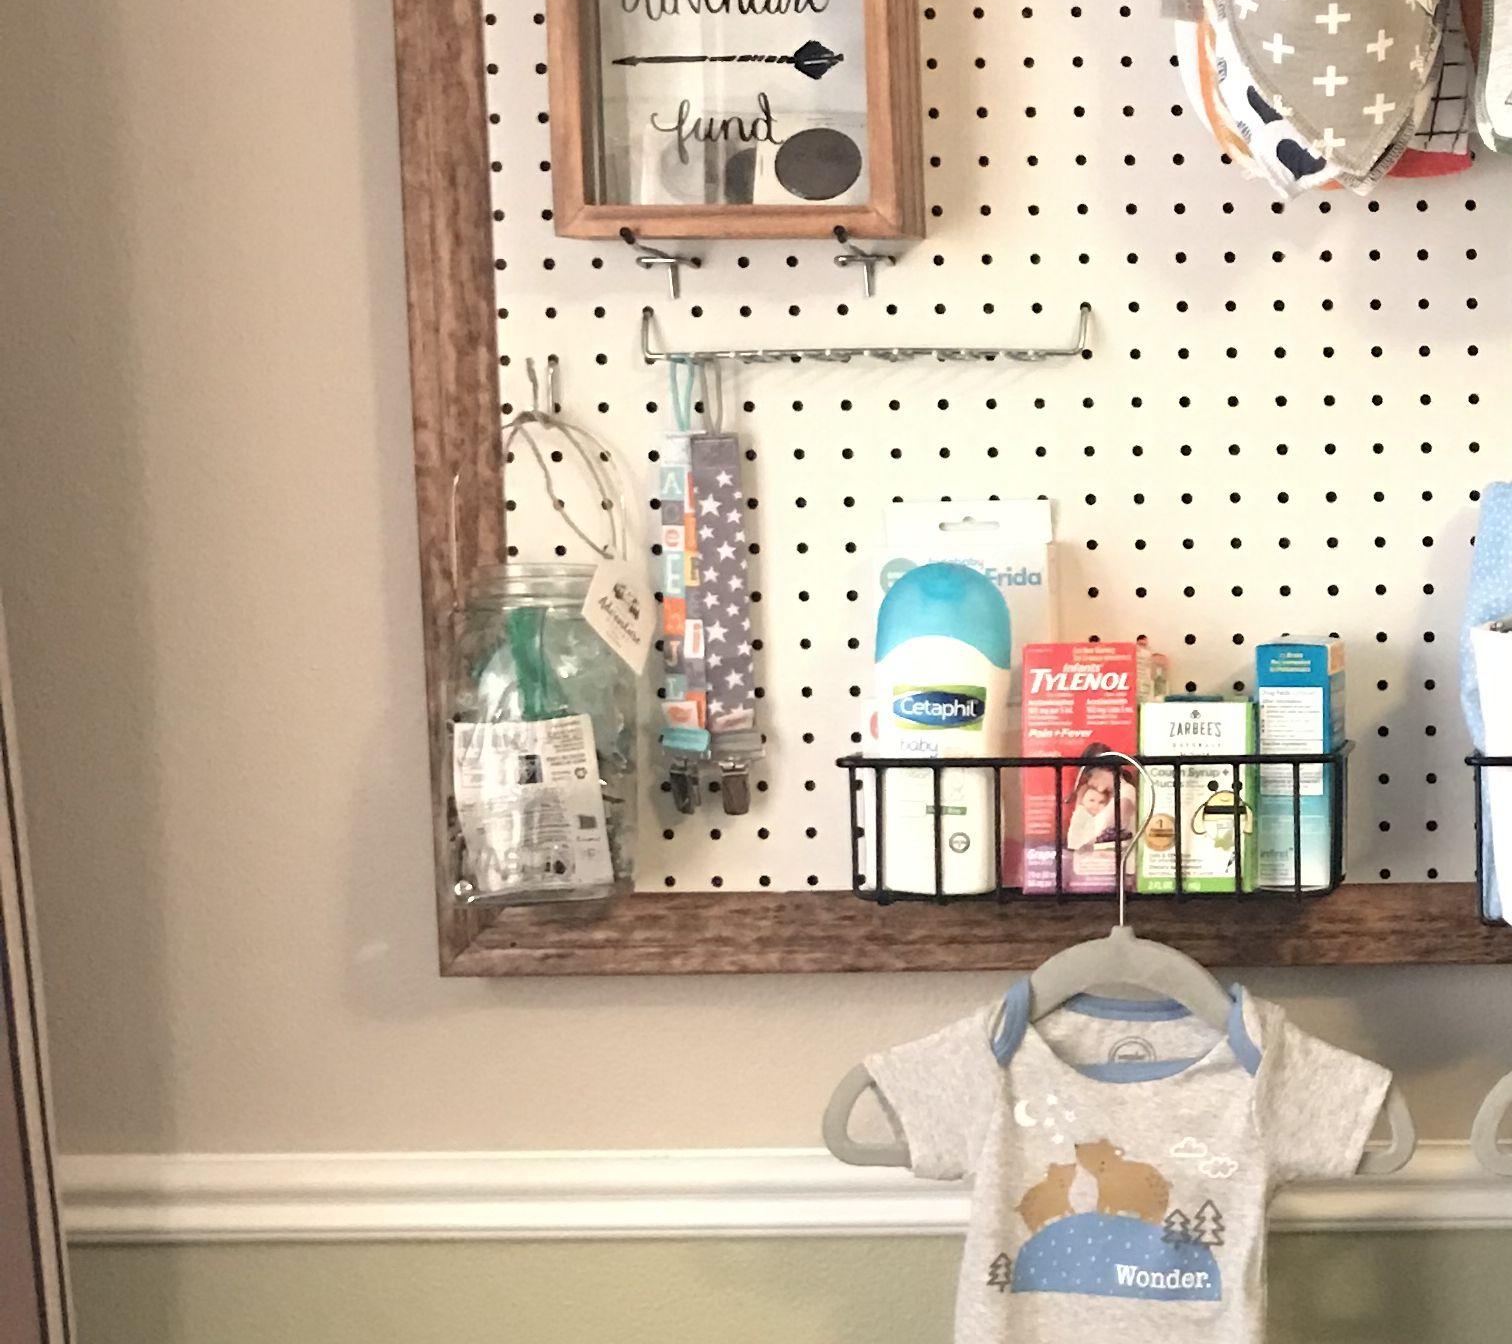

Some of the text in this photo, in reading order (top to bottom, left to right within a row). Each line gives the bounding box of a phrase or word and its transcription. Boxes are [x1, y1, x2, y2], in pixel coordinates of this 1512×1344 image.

[651, 91, 786, 165] fund
[1029, 668, 1131, 695] TYLENOL
[899, 696, 979, 725] Cetaphil
[1115, 1263, 1213, 1292] Wonder.
